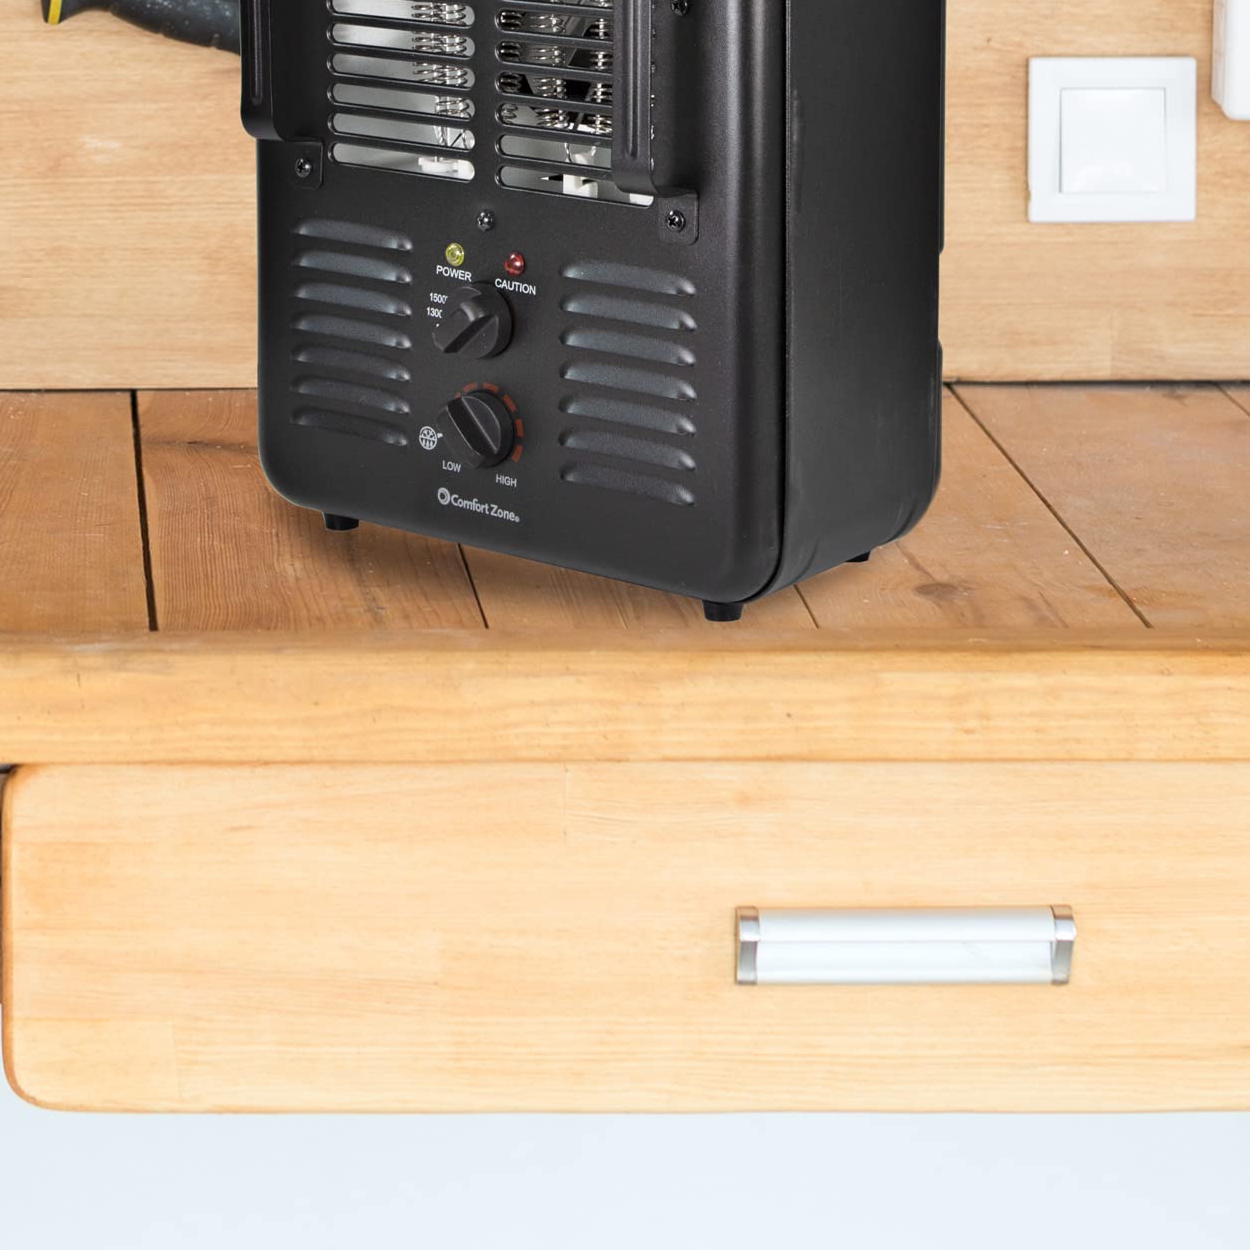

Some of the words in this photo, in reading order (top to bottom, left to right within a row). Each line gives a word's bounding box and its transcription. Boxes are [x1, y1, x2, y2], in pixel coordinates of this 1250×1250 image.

[436, 265, 472, 282] POWER
[494, 278, 537, 295] CAUTION
[429, 292, 449, 304] 1500
[442, 460, 461, 473] LOW
[495, 473, 517, 487] HIGH
[451, 494, 489, 515] Comfort
